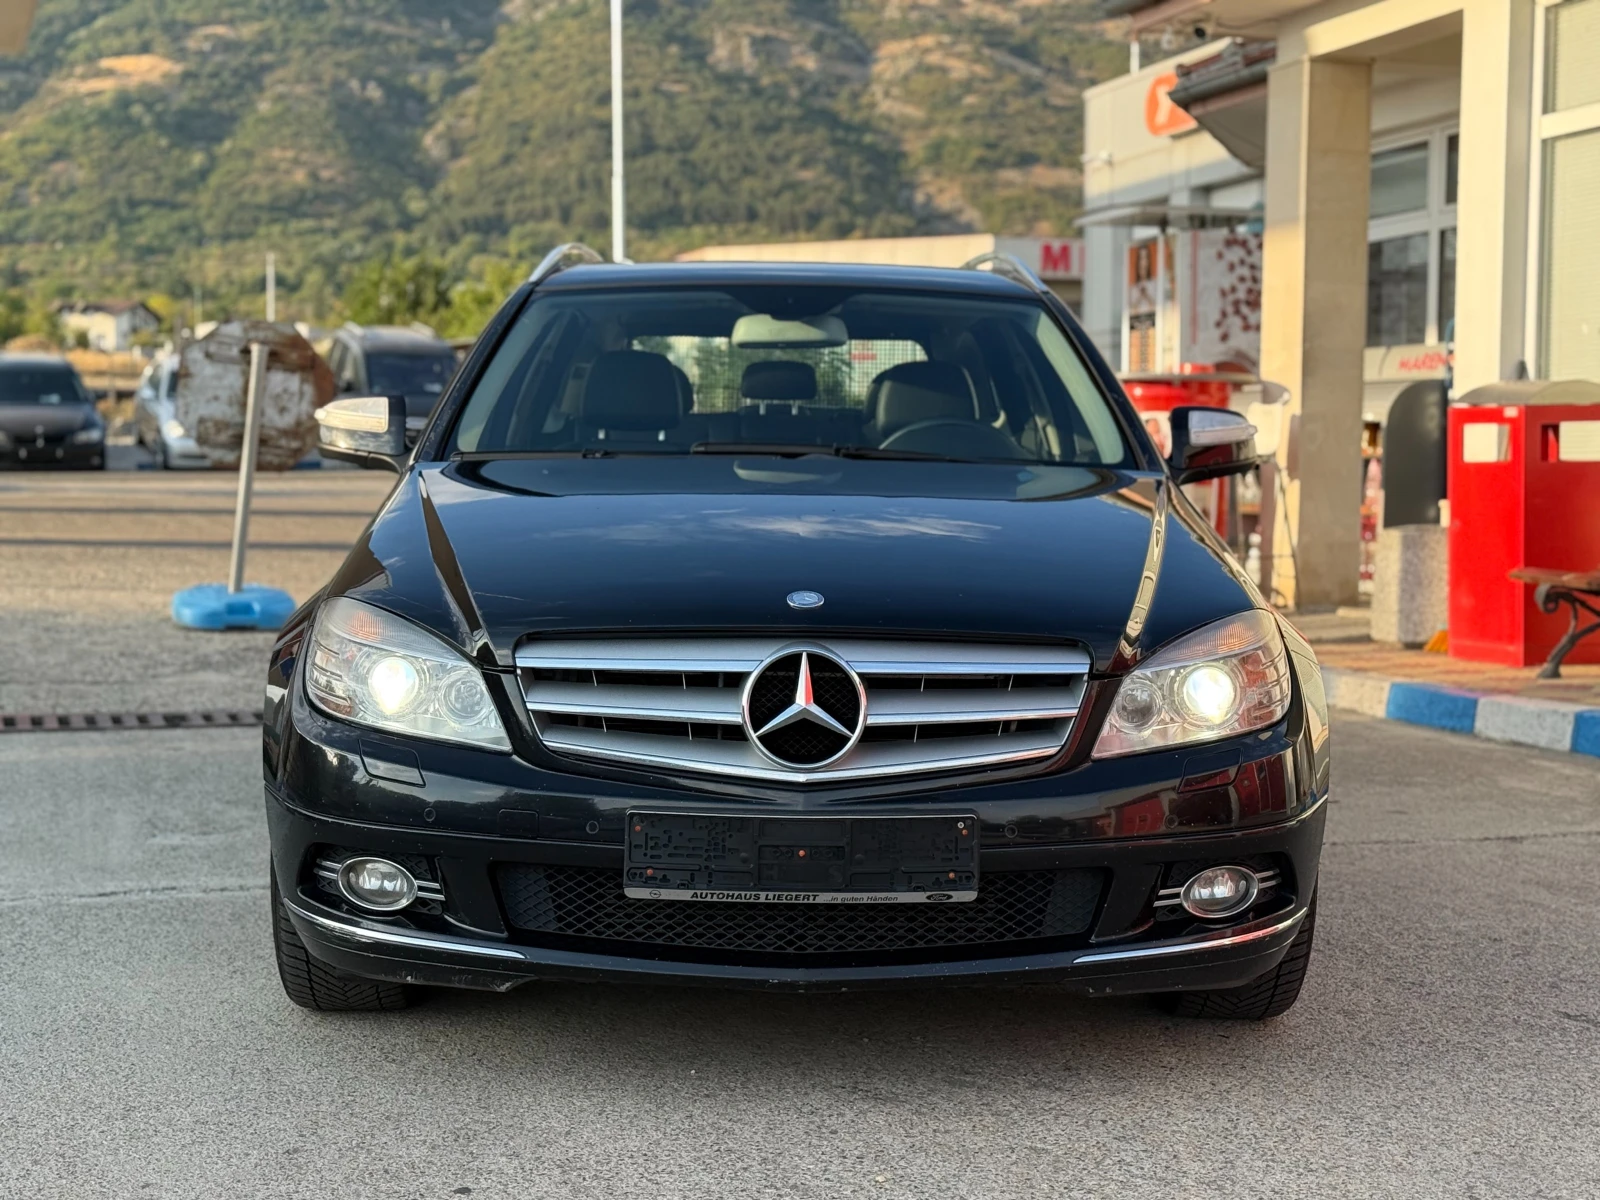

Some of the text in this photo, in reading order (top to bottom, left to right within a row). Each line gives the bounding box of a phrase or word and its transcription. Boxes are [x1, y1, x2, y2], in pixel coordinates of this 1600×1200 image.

[690, 891, 762, 901] AUTOHAUS
[765, 893, 820, 902] LIEGERT
[840, 895, 865, 904] guten
[866, 894, 899, 903] Händen
